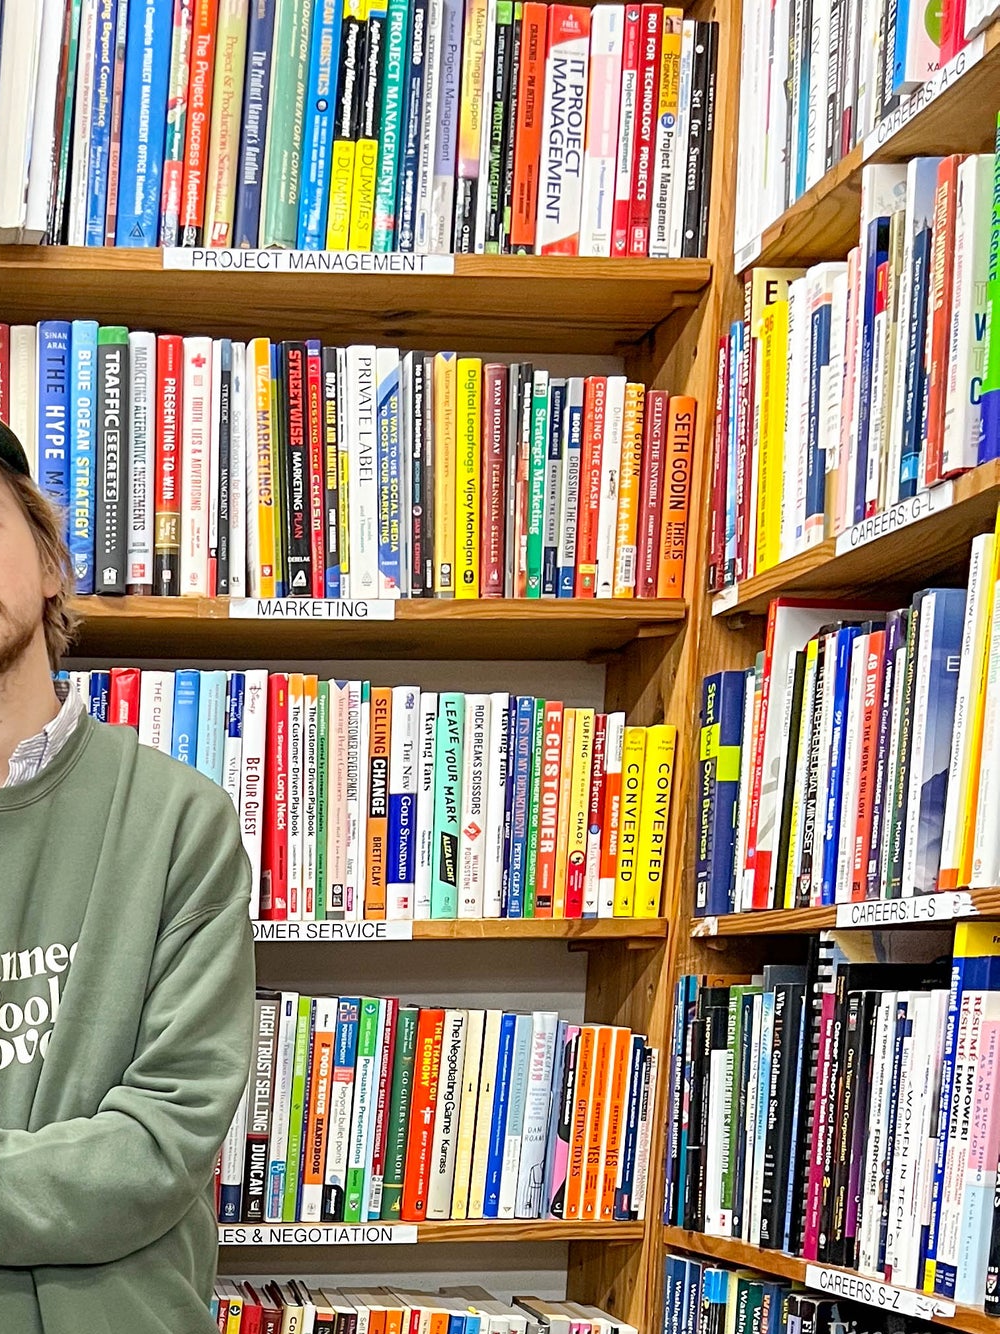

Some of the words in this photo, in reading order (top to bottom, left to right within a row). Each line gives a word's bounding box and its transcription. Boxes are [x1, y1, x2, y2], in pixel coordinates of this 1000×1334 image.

[196, 33, 211, 58] The
[194, 61, 208, 110] Project
[570, 60, 586, 78] IT
[567, 83, 585, 177] PROJECT
[877, 81, 936, 143] CAREERS:
[191, 113, 205, 164] Success
[545, 58, 569, 223] MANAGEMENT
[192, 251, 280, 269] PROJECT
[289, 252, 427, 272] MANAGEMENT
[77, 350, 91, 392] BLUE
[103, 351, 122, 427] TRAFFIC
[358, 356, 372, 426] PRIVATE
[76, 396, 91, 451] OCEAN
[674, 413, 690, 451] SETH
[106, 434, 118, 498] SECRETS
[358, 431, 373, 487] LABEL
[74, 456, 89, 538] STRATEGY
[465, 478, 475, 512] Vijay
[670, 456, 688, 512] GODIN
[465, 514, 475, 565] Mahajan
[851, 504, 909, 546] CAREERS:
[257, 600, 369, 618] MARKETING
[868, 653, 879, 670] 48
[864, 674, 877, 708] DAYS
[246, 757, 260, 773] BE
[246, 776, 259, 799] OUR
[370, 758, 386, 816] CHANGE
[245, 802, 259, 836] GUEST
[620, 764, 639, 881] CONVERTED
[648, 763, 669, 881] CONVERTED
[306, 923, 387, 938] SERVICE
[852, 903, 909, 924] CAREERS:
[259, 1005, 277, 1037] HIGH
[255, 1039, 275, 1083] TRUST
[252, 1085, 270, 1131] SELLING
[252, 1228, 264, 1243] &
[269, 1227, 393, 1243] NEGOTIATION
[819, 1271, 876, 1300] CAREERS:
